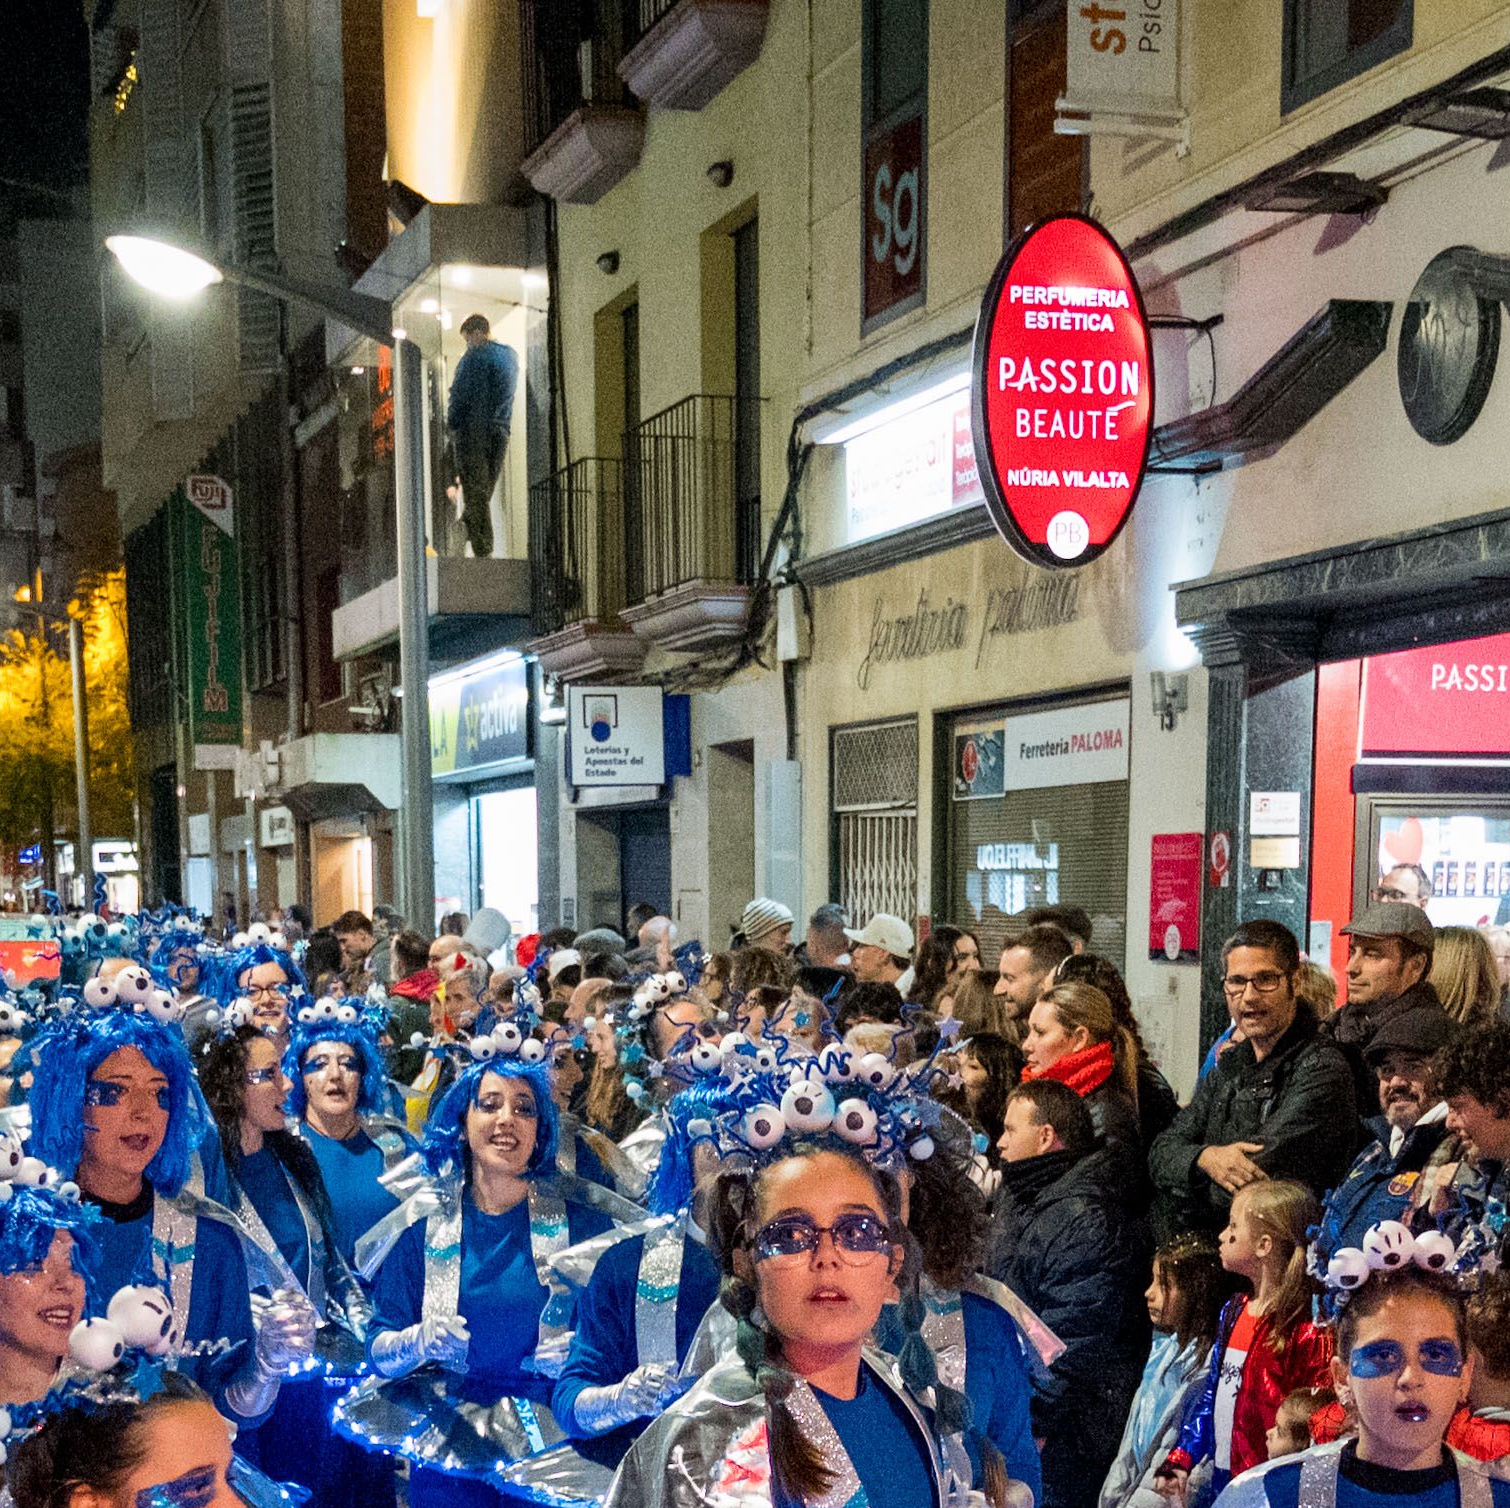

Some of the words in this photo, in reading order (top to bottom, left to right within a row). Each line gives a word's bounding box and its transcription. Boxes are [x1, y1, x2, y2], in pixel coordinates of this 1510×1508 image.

[1079, 0, 1127, 55] st
[873, 164, 919, 275] sg
[1010, 286, 1129, 309] PERFUMERIA
[1025, 309, 1115, 332] ESTÈTICA
[999, 356, 1140, 396] PASSION
[1016, 401, 1136, 440] BEAUTÉ
[1008, 466, 1060, 488] NÚRIA
[1062, 469, 1130, 489] VILALTA
[1055, 522, 1083, 546] PB
[480, 690, 518, 741] activa
[1019, 738, 1069, 760] Ferreteria
[1071, 729, 1123, 754] PALOMA
